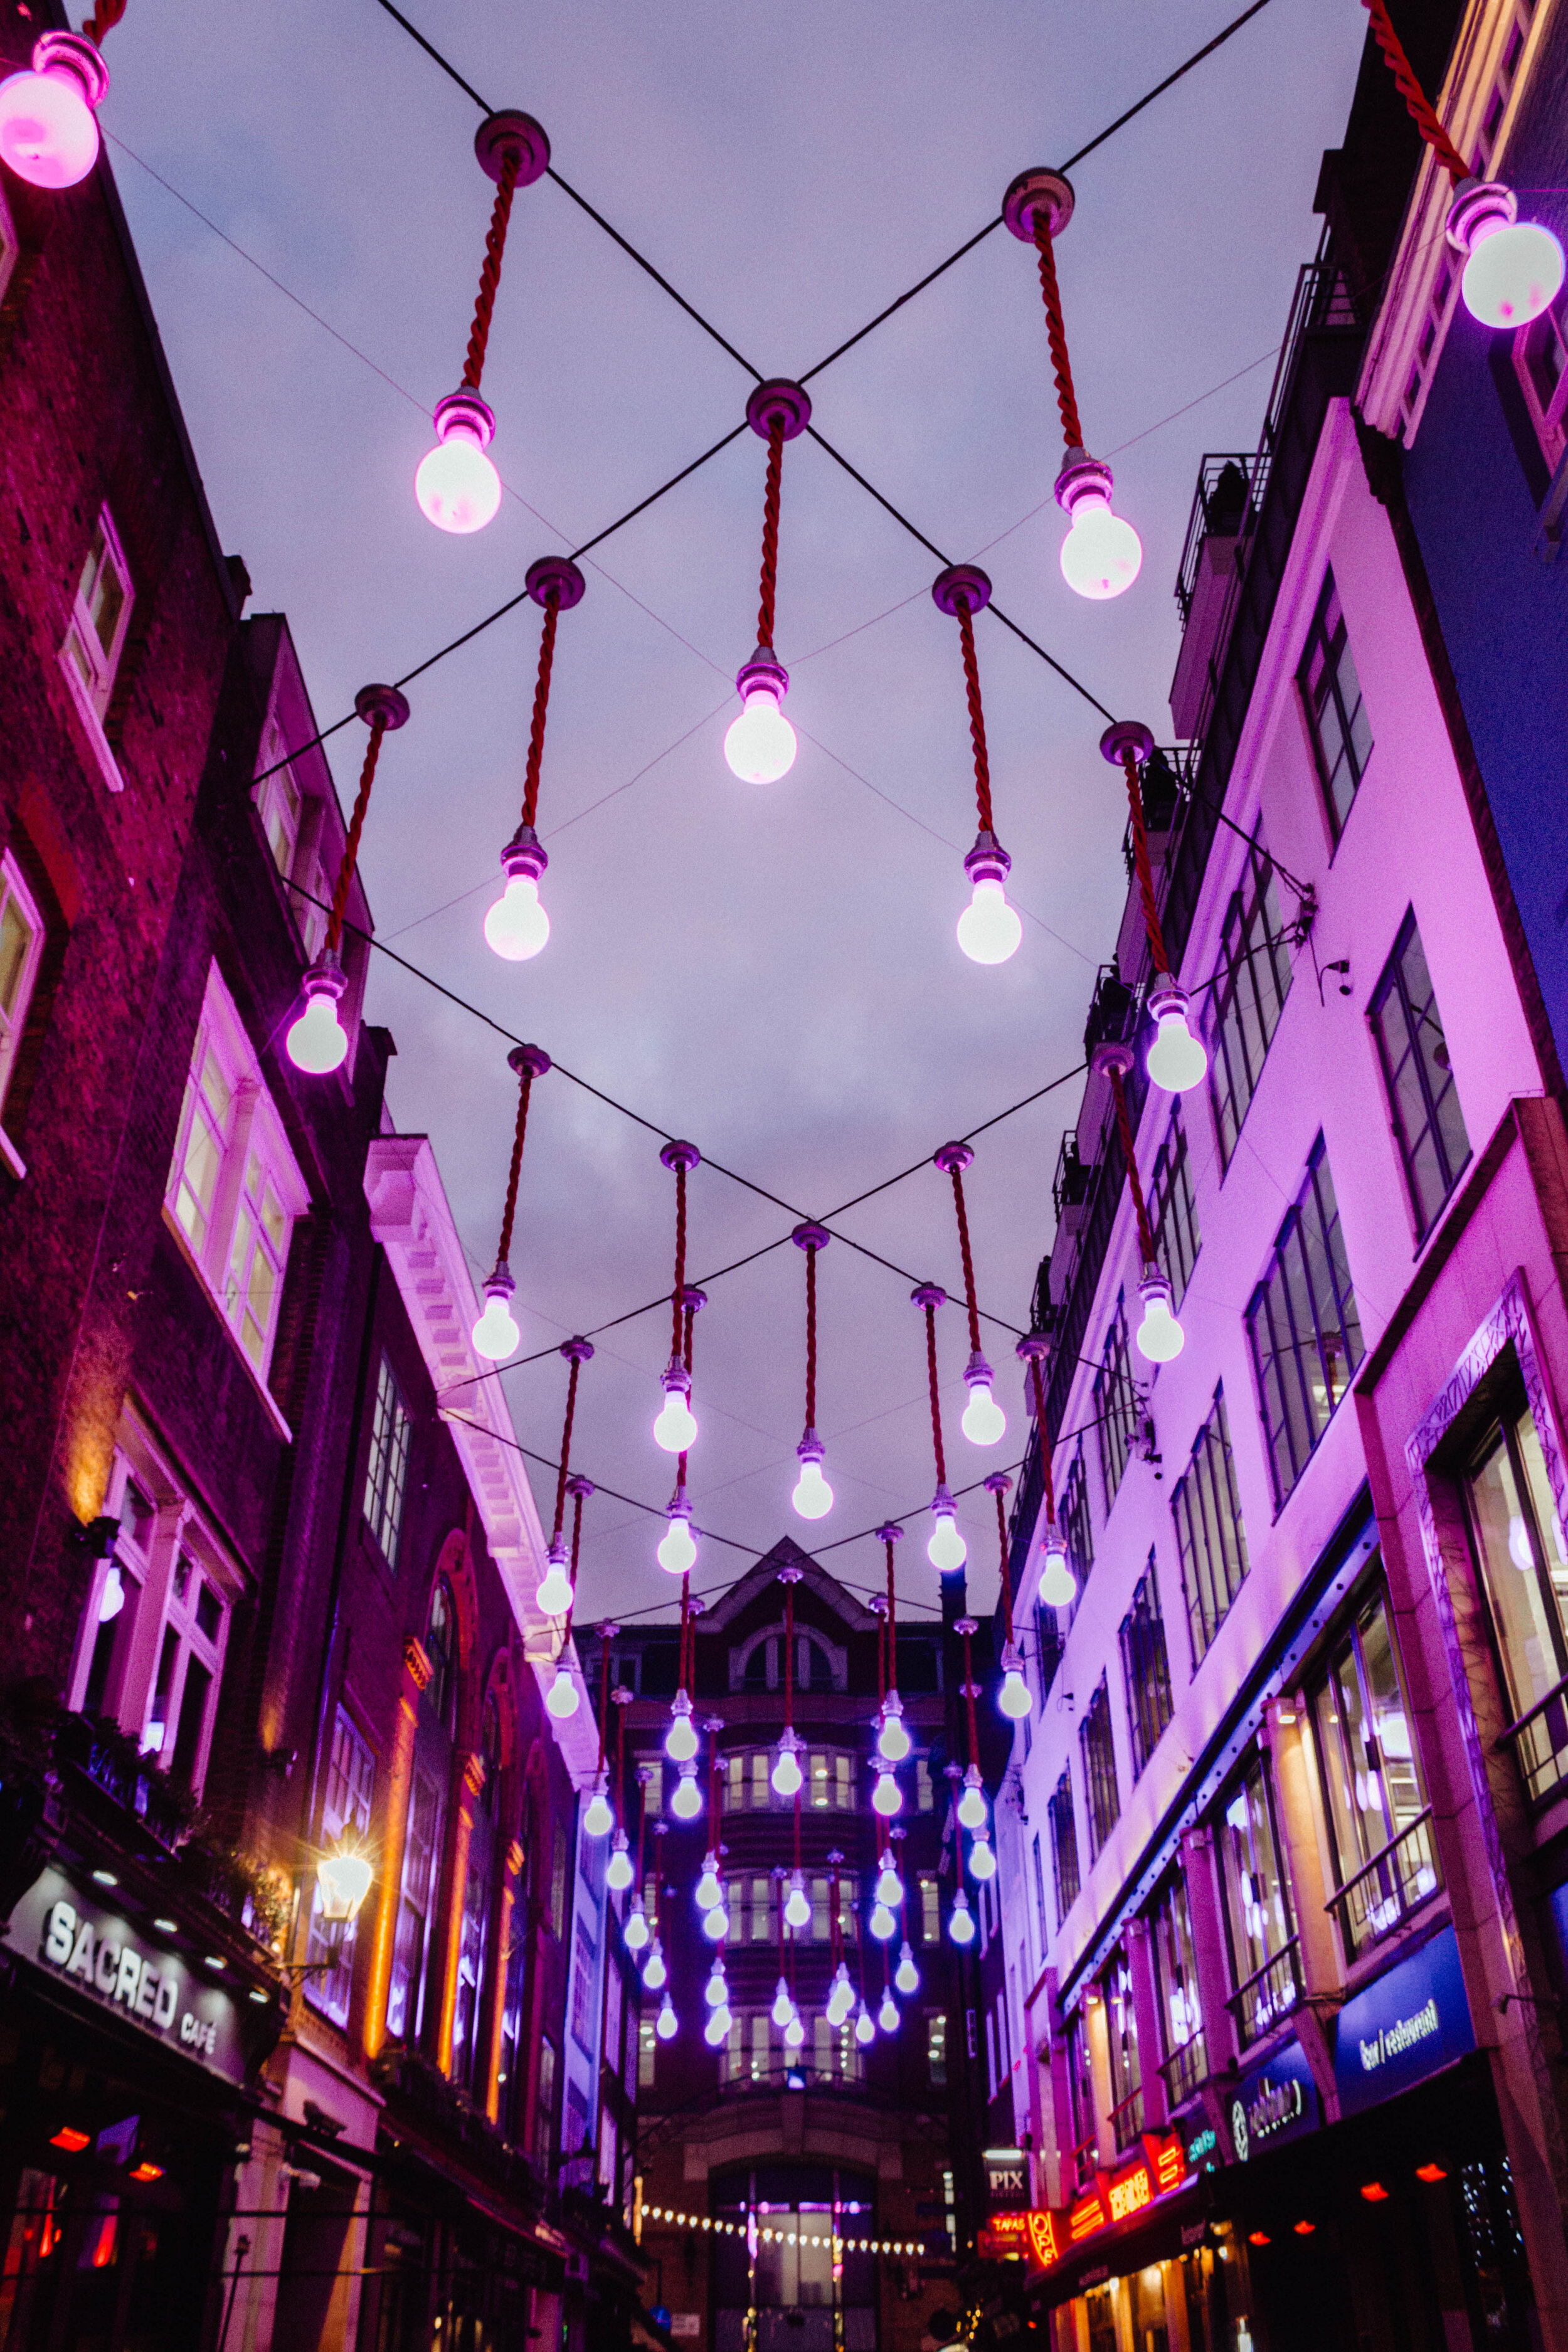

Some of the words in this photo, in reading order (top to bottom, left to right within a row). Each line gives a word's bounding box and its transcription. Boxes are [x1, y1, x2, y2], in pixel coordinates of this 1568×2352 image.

[46, 1900, 179, 2030] SACRED
[989, 2170, 1024, 2190] PIX
[992, 2217, 1025, 2232] TAPAS
